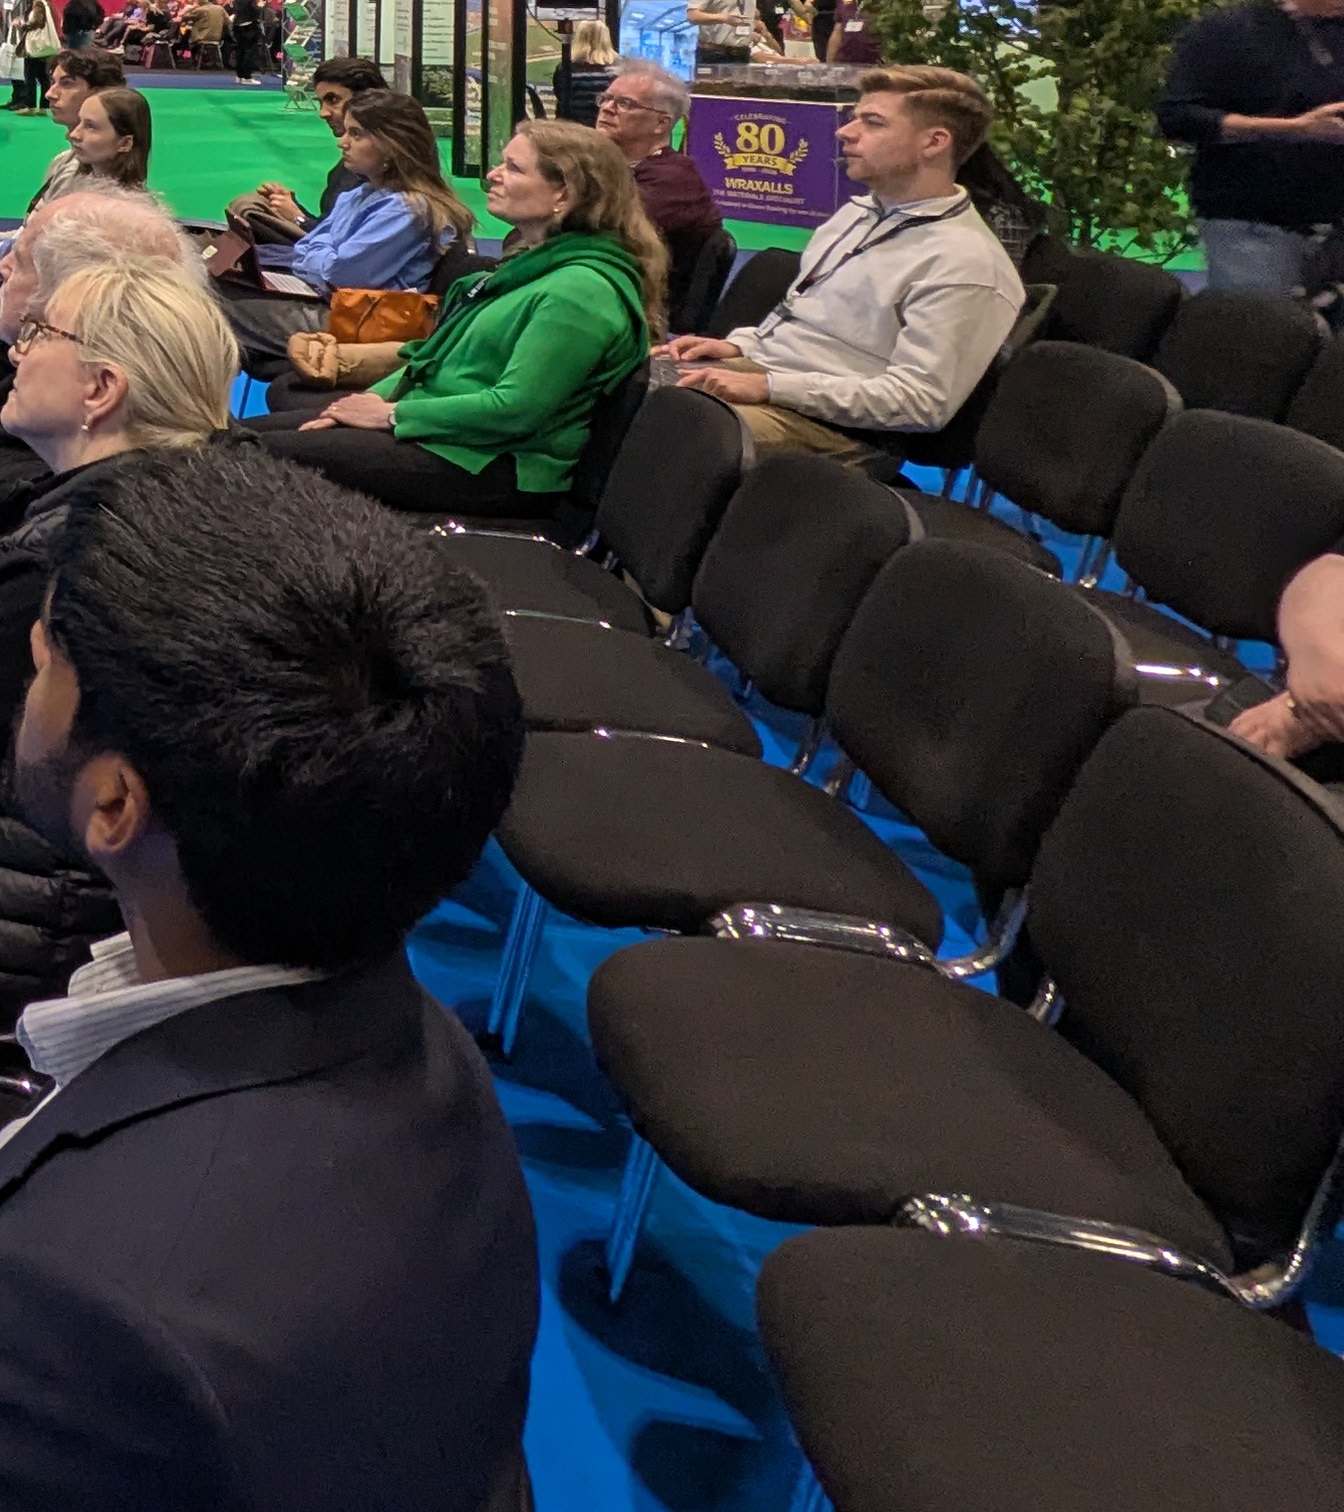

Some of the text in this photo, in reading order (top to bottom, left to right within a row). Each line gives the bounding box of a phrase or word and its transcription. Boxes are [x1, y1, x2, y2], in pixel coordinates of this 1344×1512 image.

[736, 121, 785, 155] 80
[742, 155, 778, 166] YEARS
[724, 177, 794, 195] WRAXALLS
